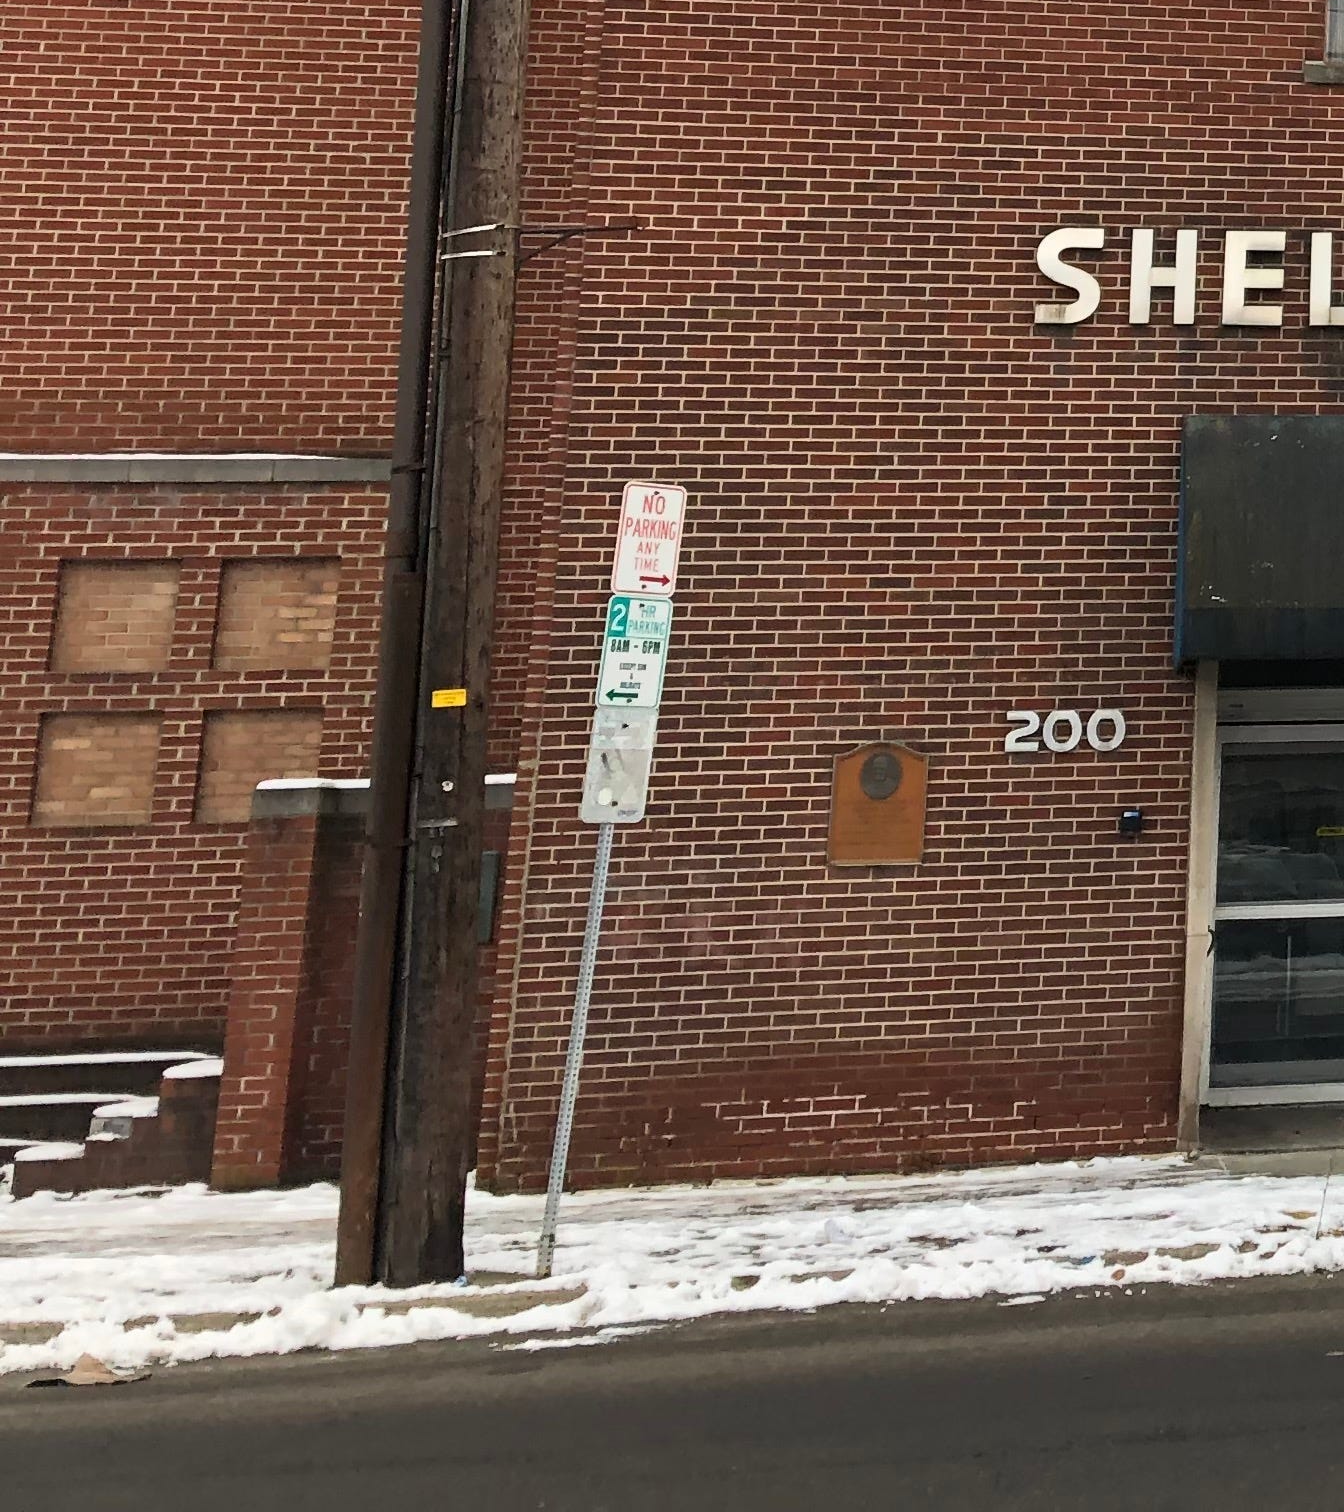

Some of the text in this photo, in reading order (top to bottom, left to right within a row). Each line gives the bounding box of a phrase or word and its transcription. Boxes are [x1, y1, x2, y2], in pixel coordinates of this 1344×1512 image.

[642, 494, 665, 514] NO
[625, 517, 677, 540] PARKING
[636, 541, 660, 554] ANY
[634, 557, 660, 572] TIME
[610, 603, 656, 631] 2 HR
[628, 619, 666, 635] PARKING
[610, 639, 630, 653] 8AM
[642, 640, 661, 654] 6PM
[1004, 709, 1126, 752] 200
